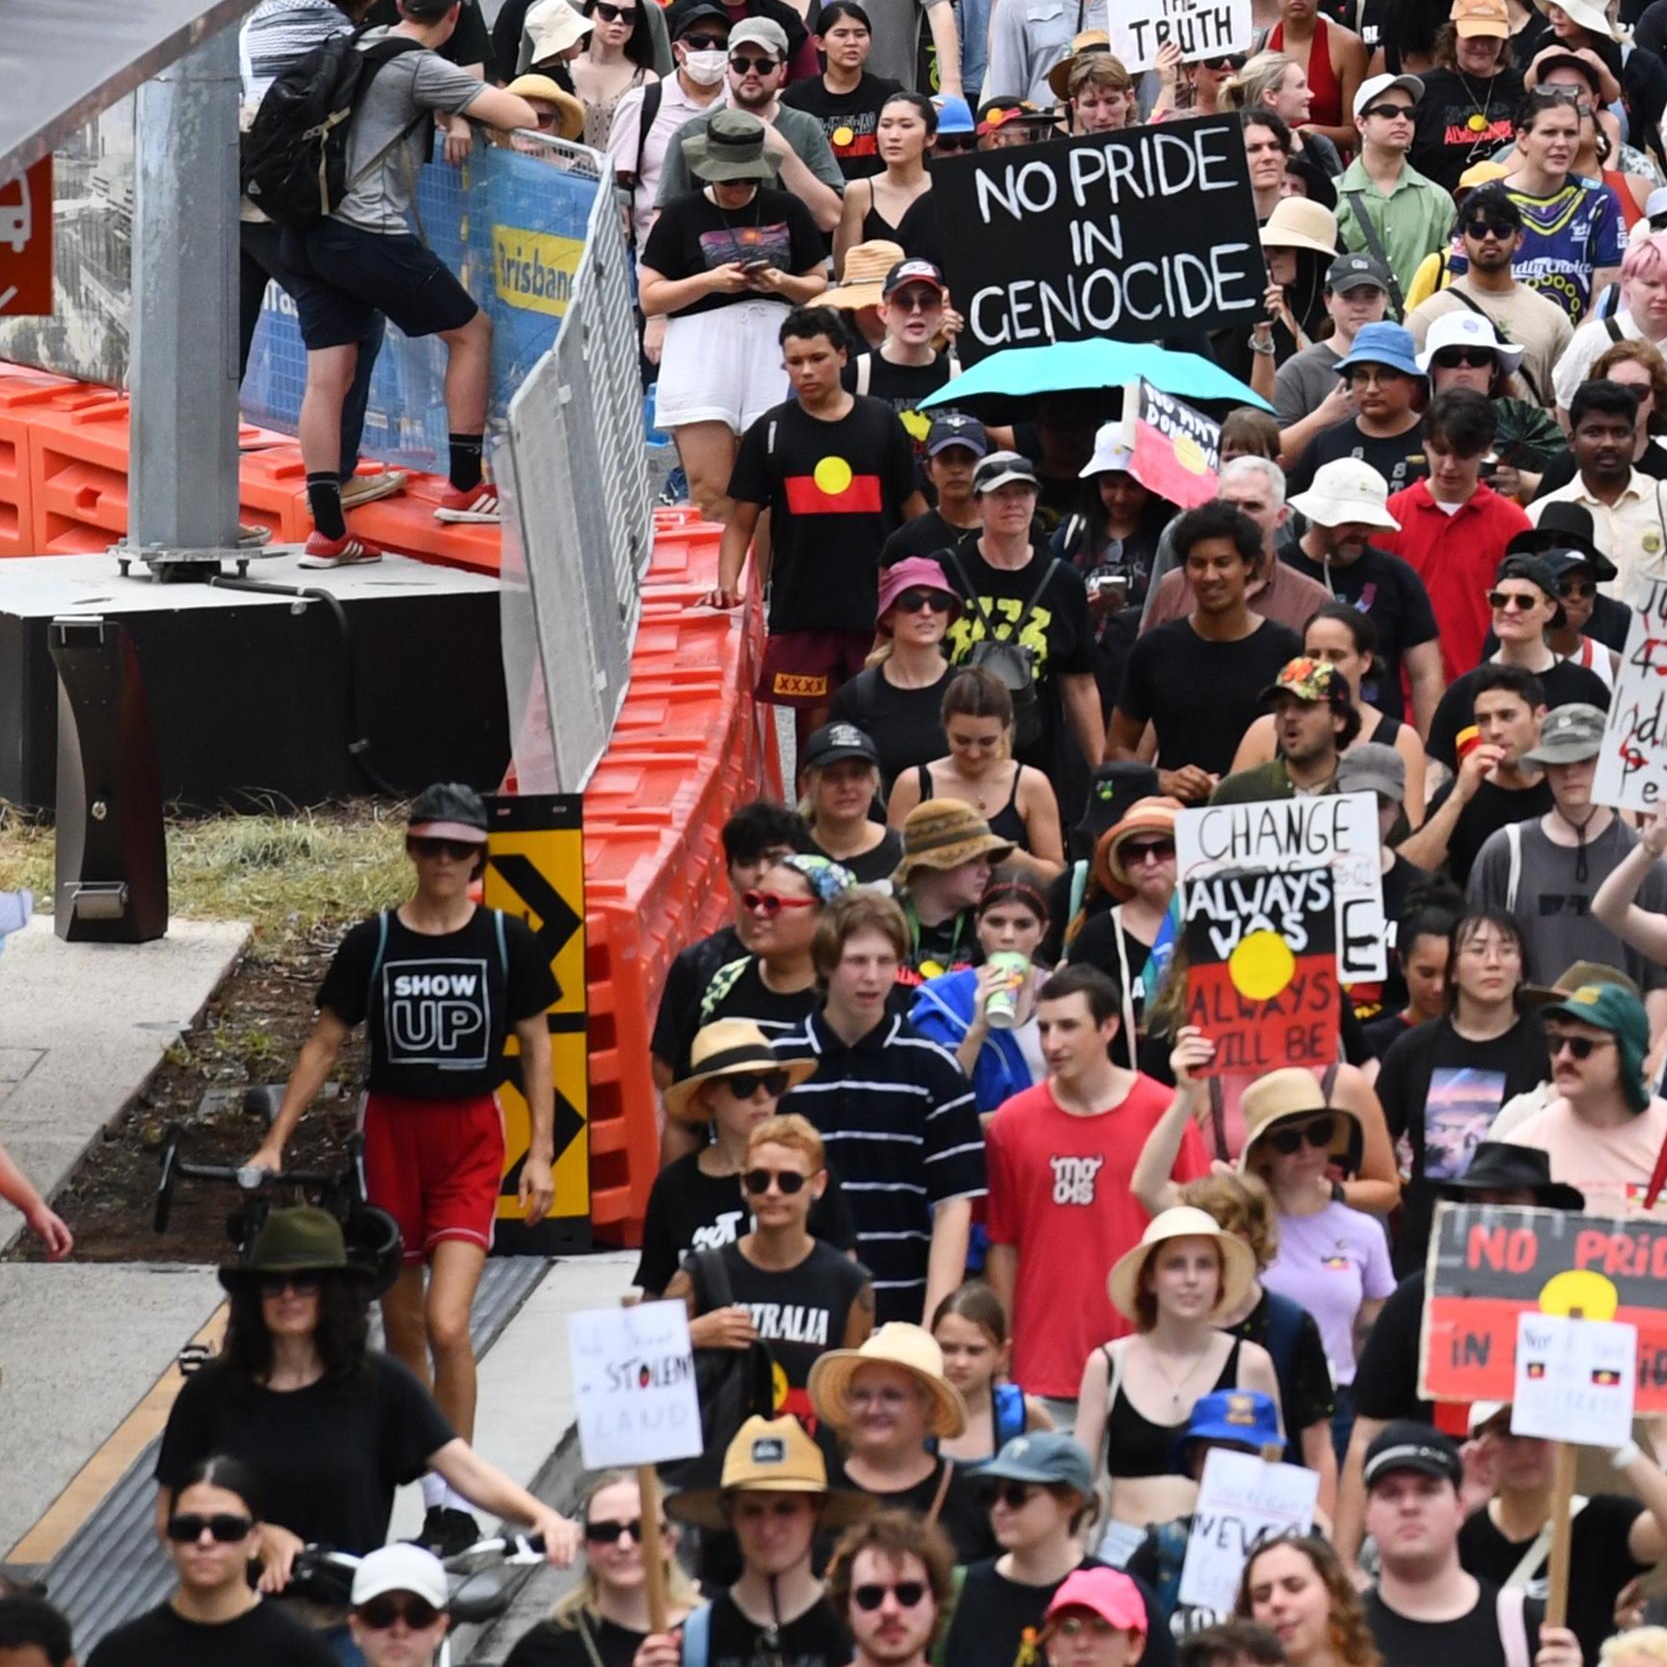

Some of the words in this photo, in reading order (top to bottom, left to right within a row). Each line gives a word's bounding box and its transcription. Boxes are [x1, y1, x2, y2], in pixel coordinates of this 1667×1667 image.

[1129, 5, 1232, 62] TRUTH
[975, 160, 1058, 223] NO
[1070, 127, 1241, 207] PRIDE
[1072, 215, 1126, 266] IN
[970, 244, 1258, 348] GENOCIDE
[779, 677, 826, 691] XXXX
[1197, 808, 1351, 859] CHANGE
[1184, 869, 1332, 923] ALWAYS
[395, 973, 478, 998] SHOW
[393, 1000, 484, 1051] UP
[1285, 1020, 1326, 1061] BE
[1467, 1225, 1536, 1273] NO
